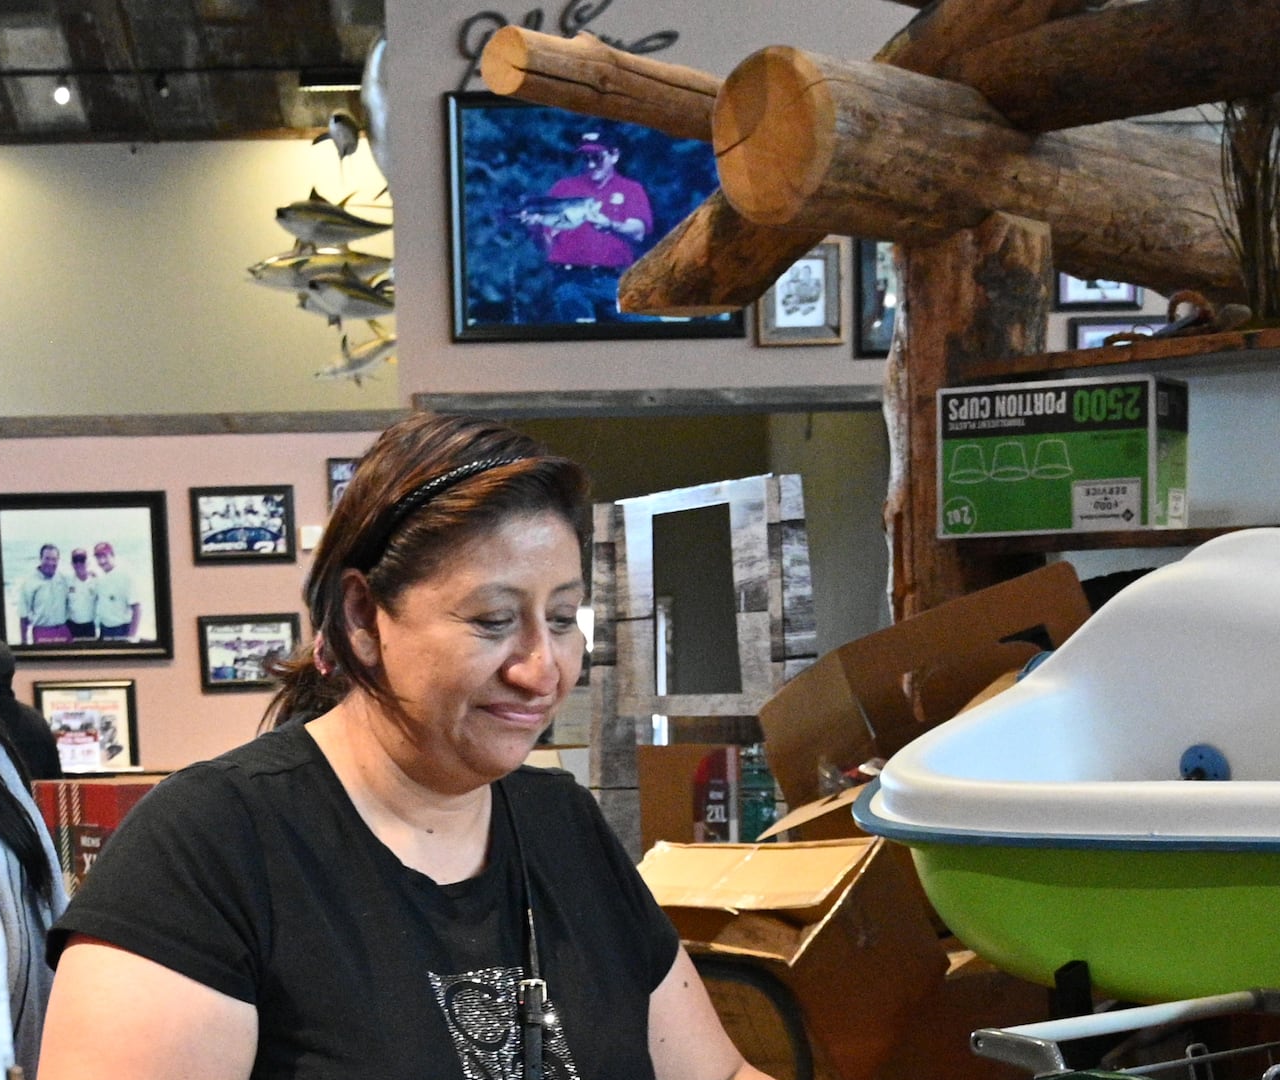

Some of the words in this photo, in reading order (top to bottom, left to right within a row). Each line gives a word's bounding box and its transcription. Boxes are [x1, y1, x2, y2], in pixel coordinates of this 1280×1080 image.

[948, 395, 991, 421] CUPS
[995, 391, 1067, 417] PORTION
[1073, 386, 1142, 423] 2500
[1084, 486, 1128, 496] SERVICE
